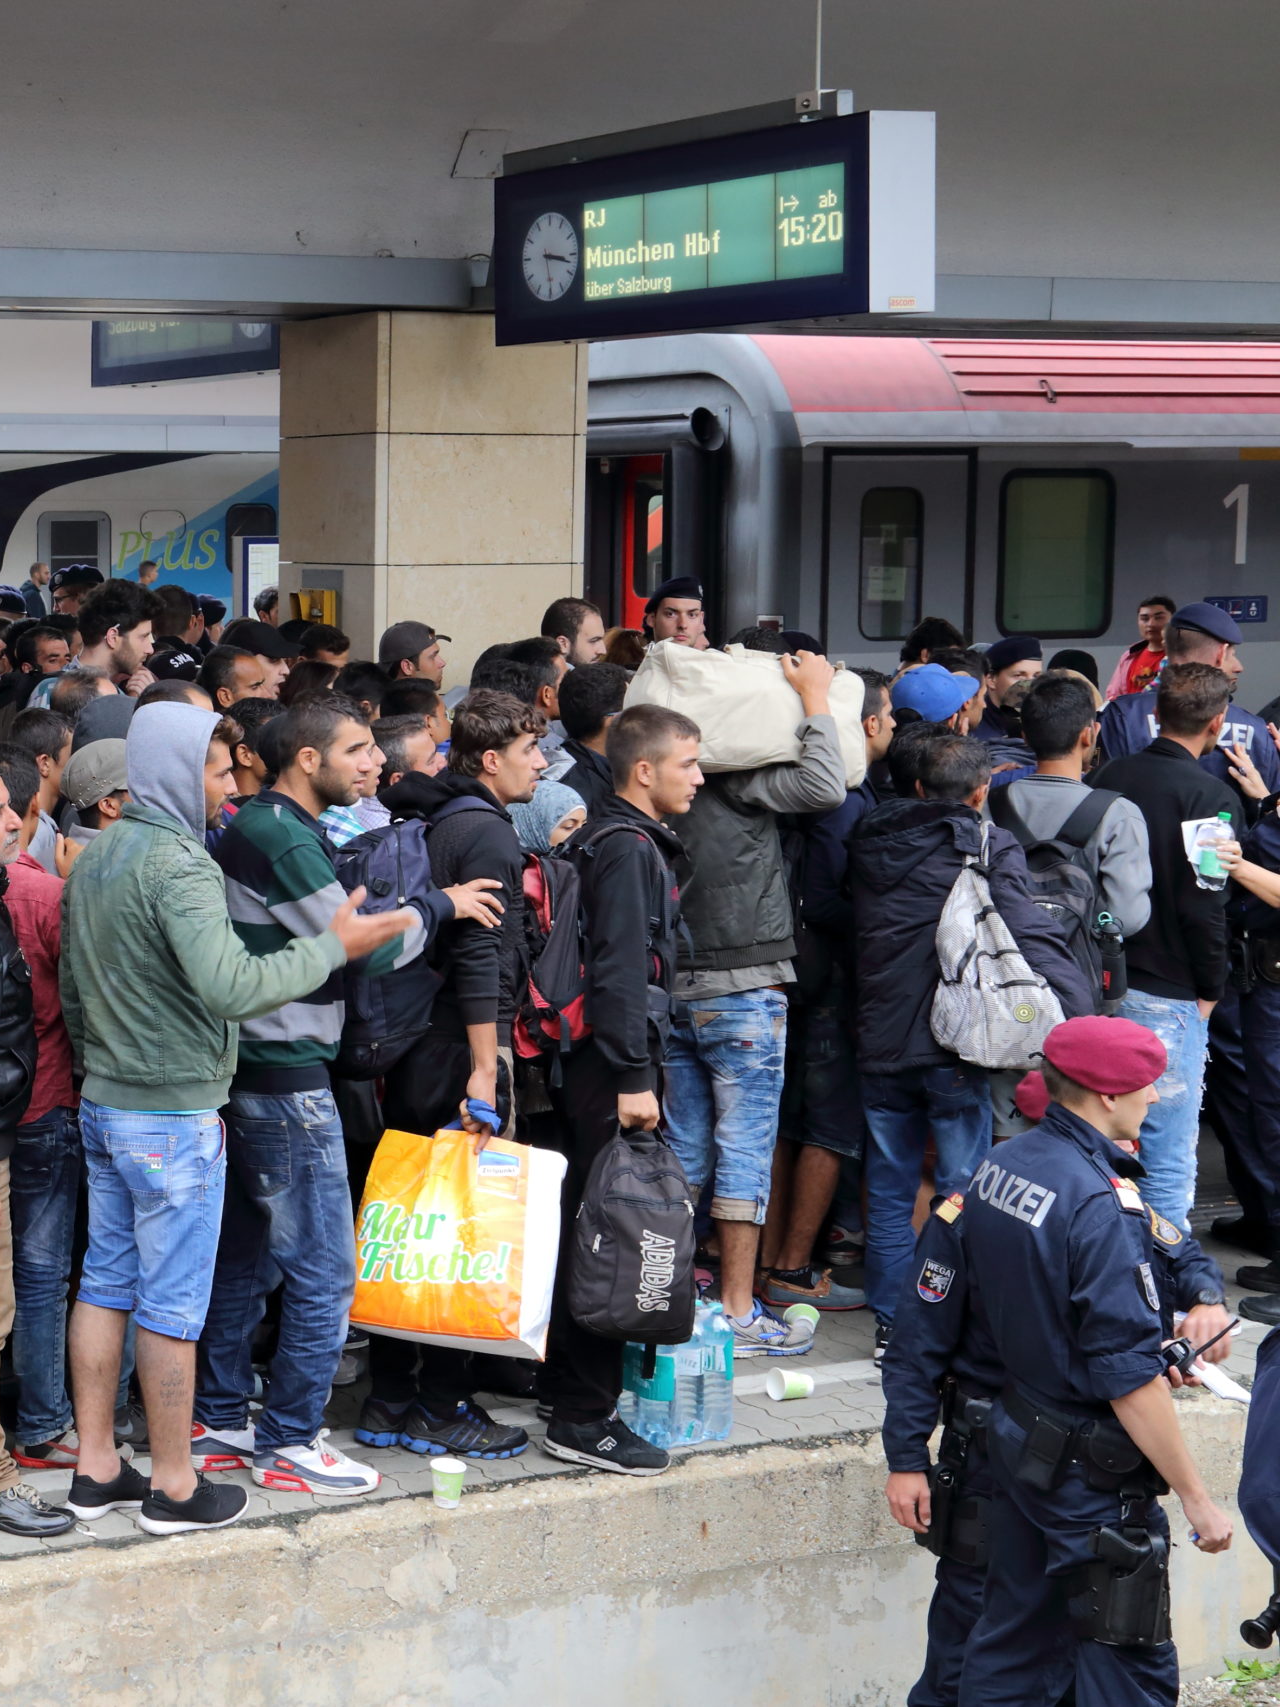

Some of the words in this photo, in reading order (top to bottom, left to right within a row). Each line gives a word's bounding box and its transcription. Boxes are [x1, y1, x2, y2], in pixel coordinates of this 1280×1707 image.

[819, 190, 837, 208] ab
[584, 209, 606, 228] RJ
[778, 211, 843, 247] 15:20
[586, 240, 675, 269] München
[685, 230, 720, 257] Hbf
[587, 280, 613, 298] über
[617, 276, 672, 293] Salzburg
[1223, 483, 1250, 564] 1
[116, 529, 219, 571] PLUS
[968, 1160, 1057, 1228] POLIZEI
[635, 1229, 677, 1313] ADIDAS
[927, 1261, 951, 1278] WEGA
